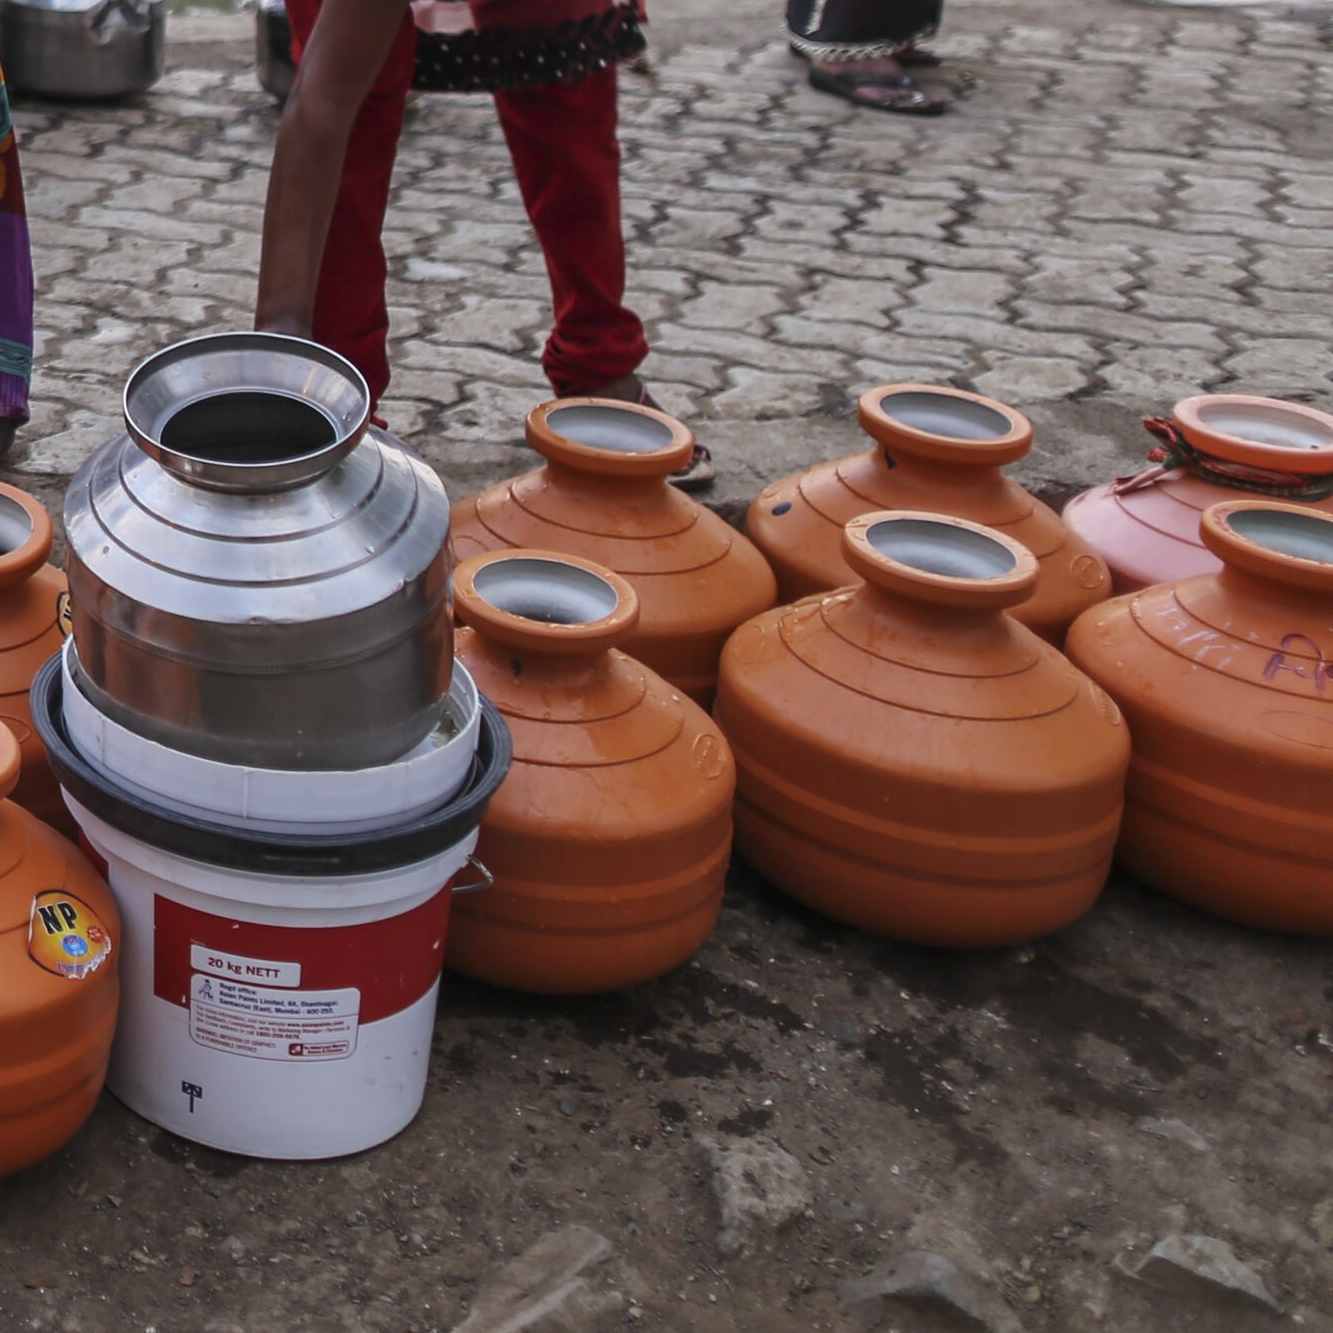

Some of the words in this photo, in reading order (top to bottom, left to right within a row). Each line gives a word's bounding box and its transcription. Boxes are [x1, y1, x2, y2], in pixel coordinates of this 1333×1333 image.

[36, 901, 78, 936] NP
[207, 956, 224, 969] 20
[226, 961, 243, 975] kg
[245, 965, 281, 979] NETT
[219, 990, 237, 999] Asian
[238, 994, 258, 1004] Paints
[219, 997, 251, 1010] Santacruz
[274, 1007, 301, 1015] Mumbai
